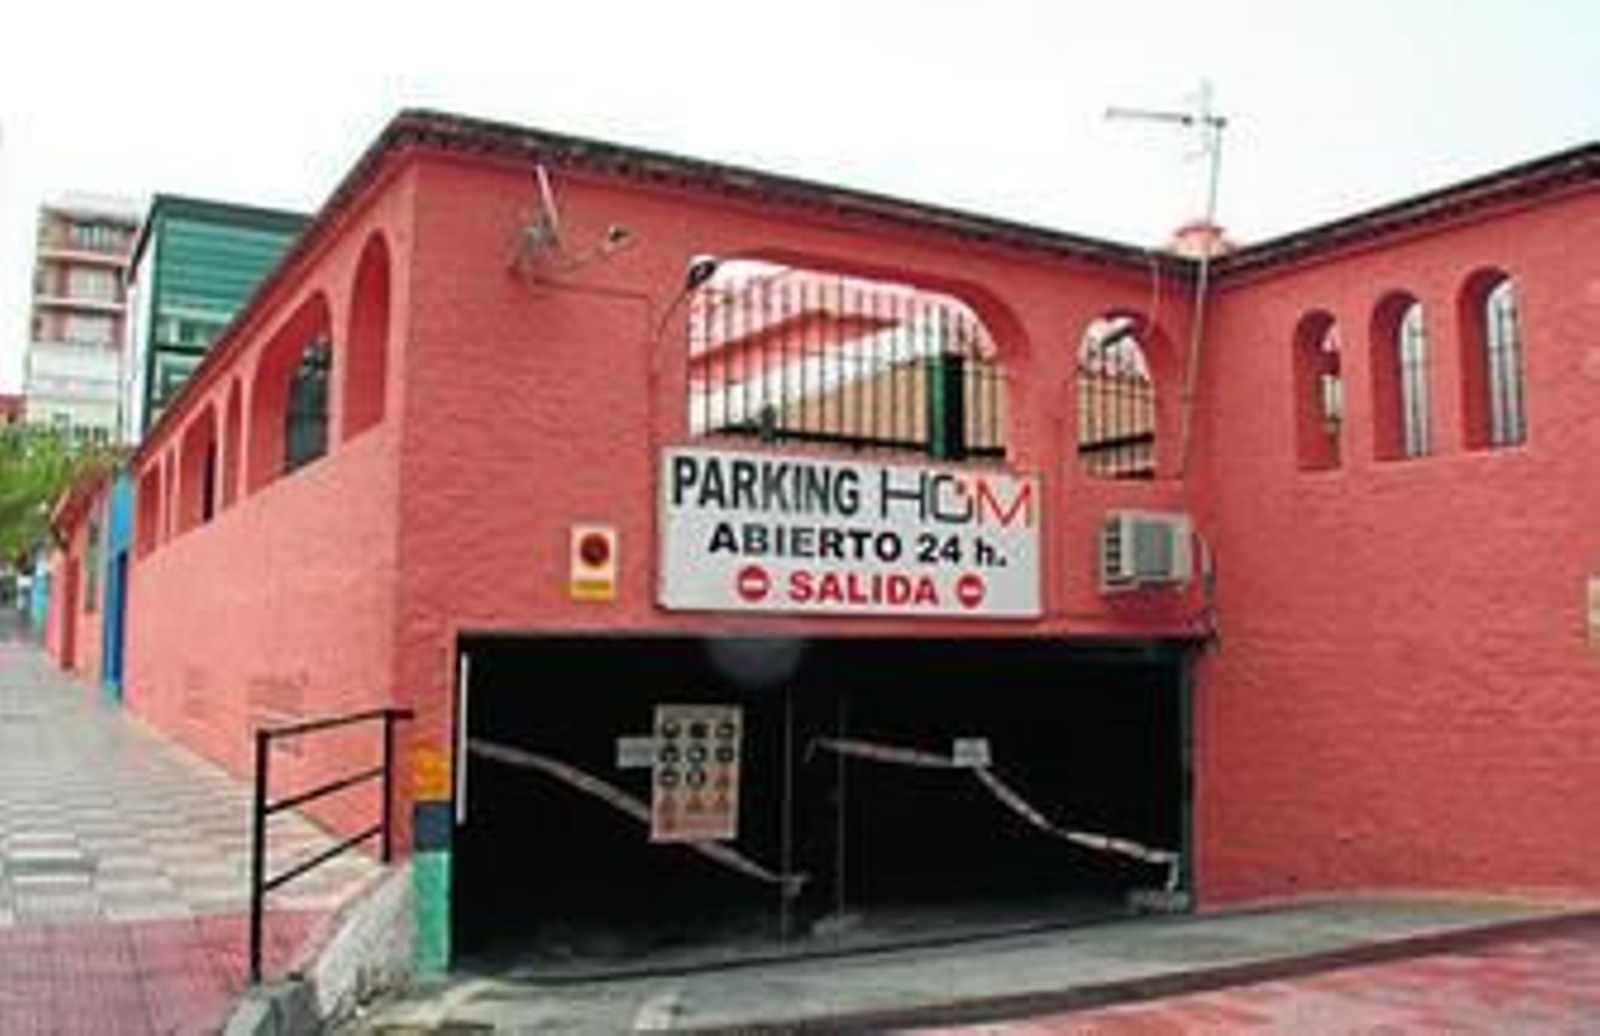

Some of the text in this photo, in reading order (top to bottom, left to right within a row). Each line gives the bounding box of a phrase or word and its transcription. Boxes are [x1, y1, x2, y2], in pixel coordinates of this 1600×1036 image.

[672, 456, 859, 516] PARKING
[708, 523, 1007, 566] ABIERTO 24 h.
[789, 570, 939, 605] SALIDA
